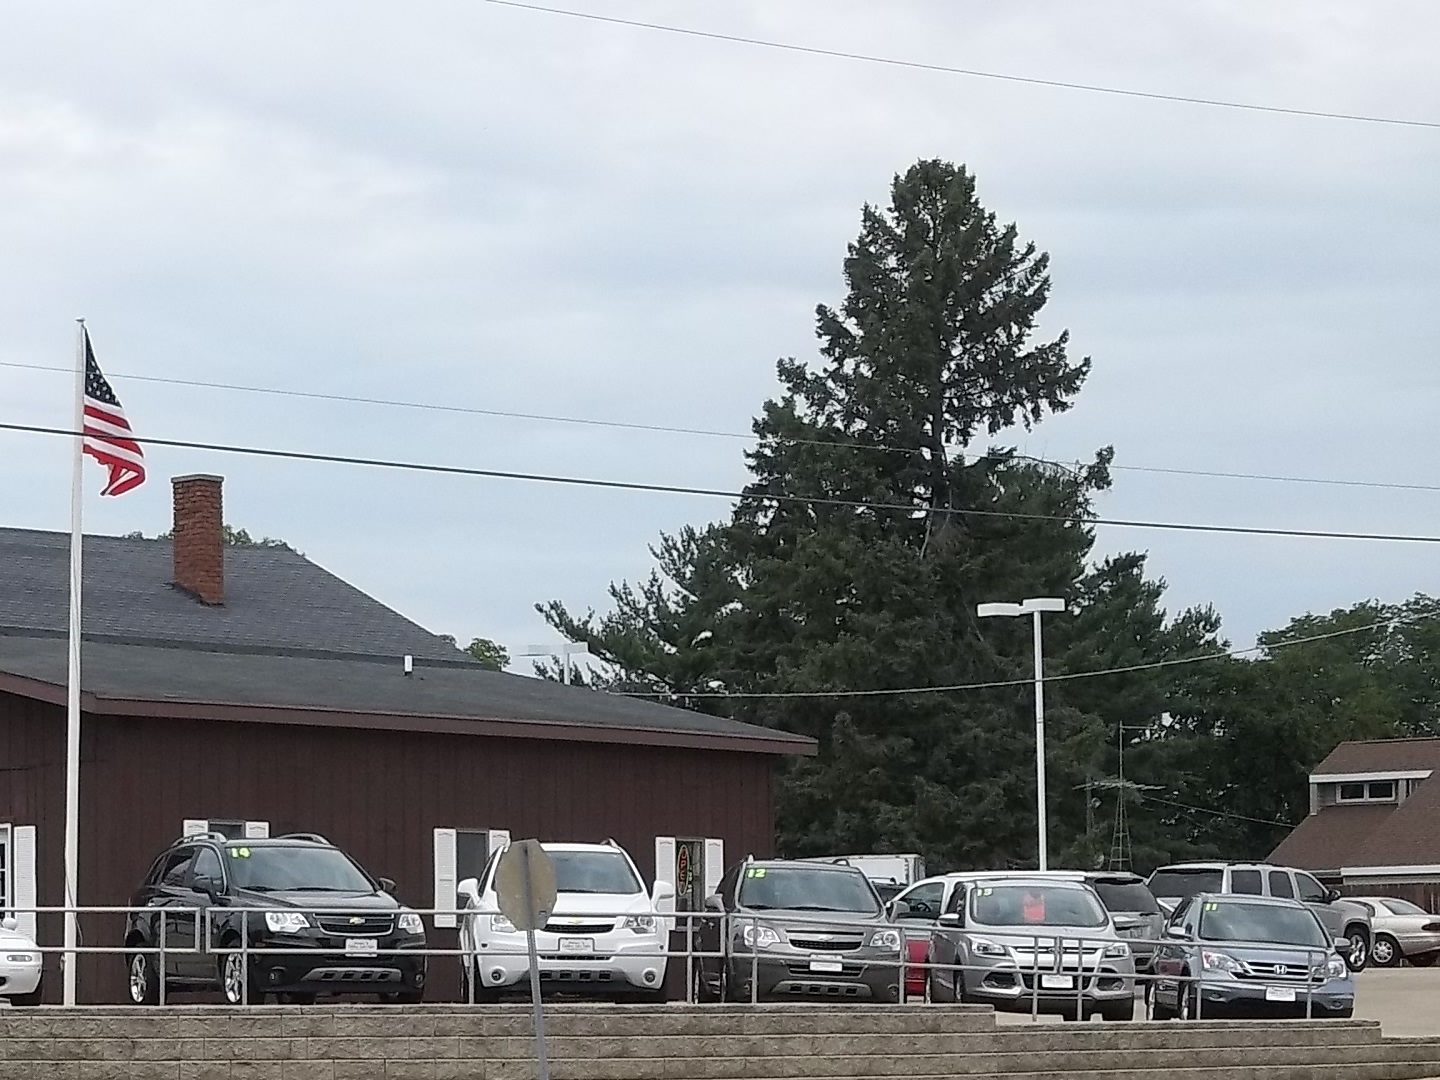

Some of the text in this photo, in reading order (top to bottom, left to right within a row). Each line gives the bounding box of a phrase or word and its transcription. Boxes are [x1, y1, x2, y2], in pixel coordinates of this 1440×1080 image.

[231, 847, 251, 858] 14
[747, 868, 766, 878] 12
[1205, 902, 1218, 911] 11
